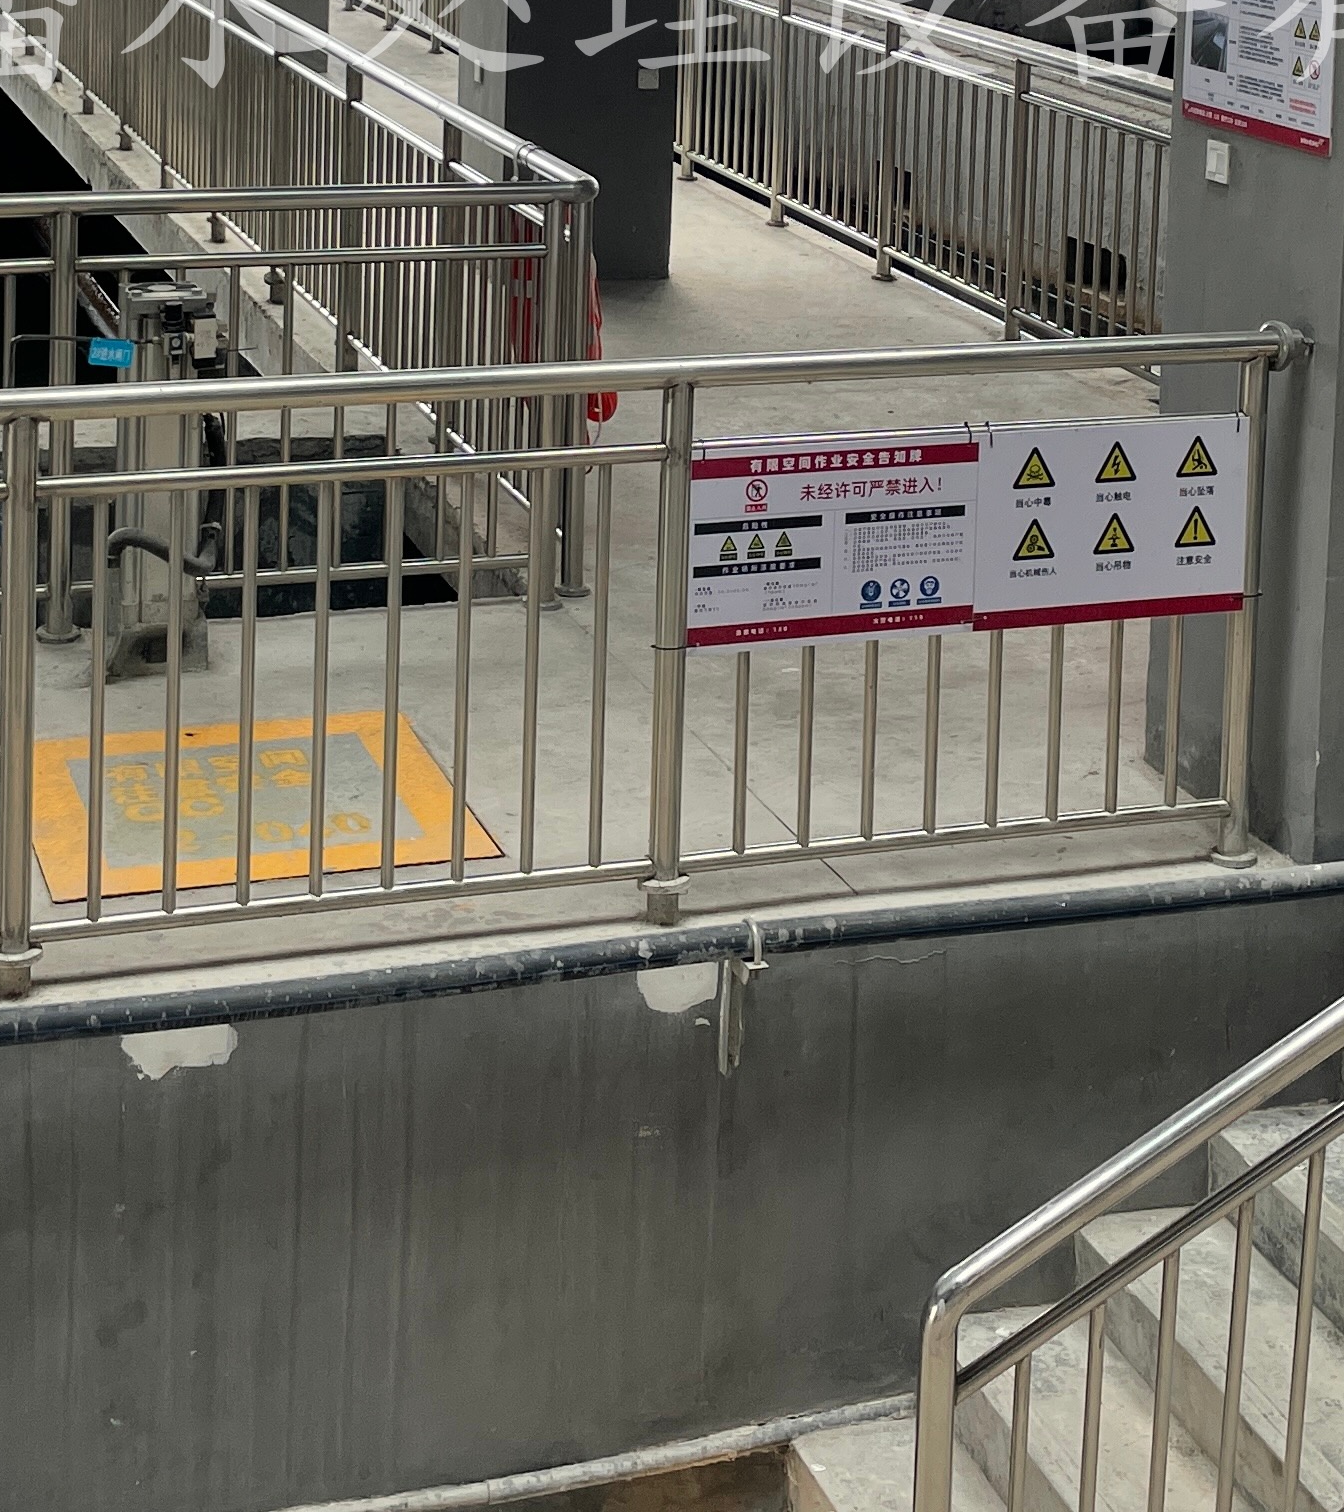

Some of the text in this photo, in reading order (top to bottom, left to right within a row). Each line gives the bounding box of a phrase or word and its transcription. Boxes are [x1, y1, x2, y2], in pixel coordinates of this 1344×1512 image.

[1095, 490, 1132, 503] 当心触电
[1179, 485, 1216, 497] 当心坠落
[1095, 559, 1132, 572] 当心吊物
[1175, 554, 1213, 566] 注意安全
[1009, 566, 1057, 579] 当心机械伤人
